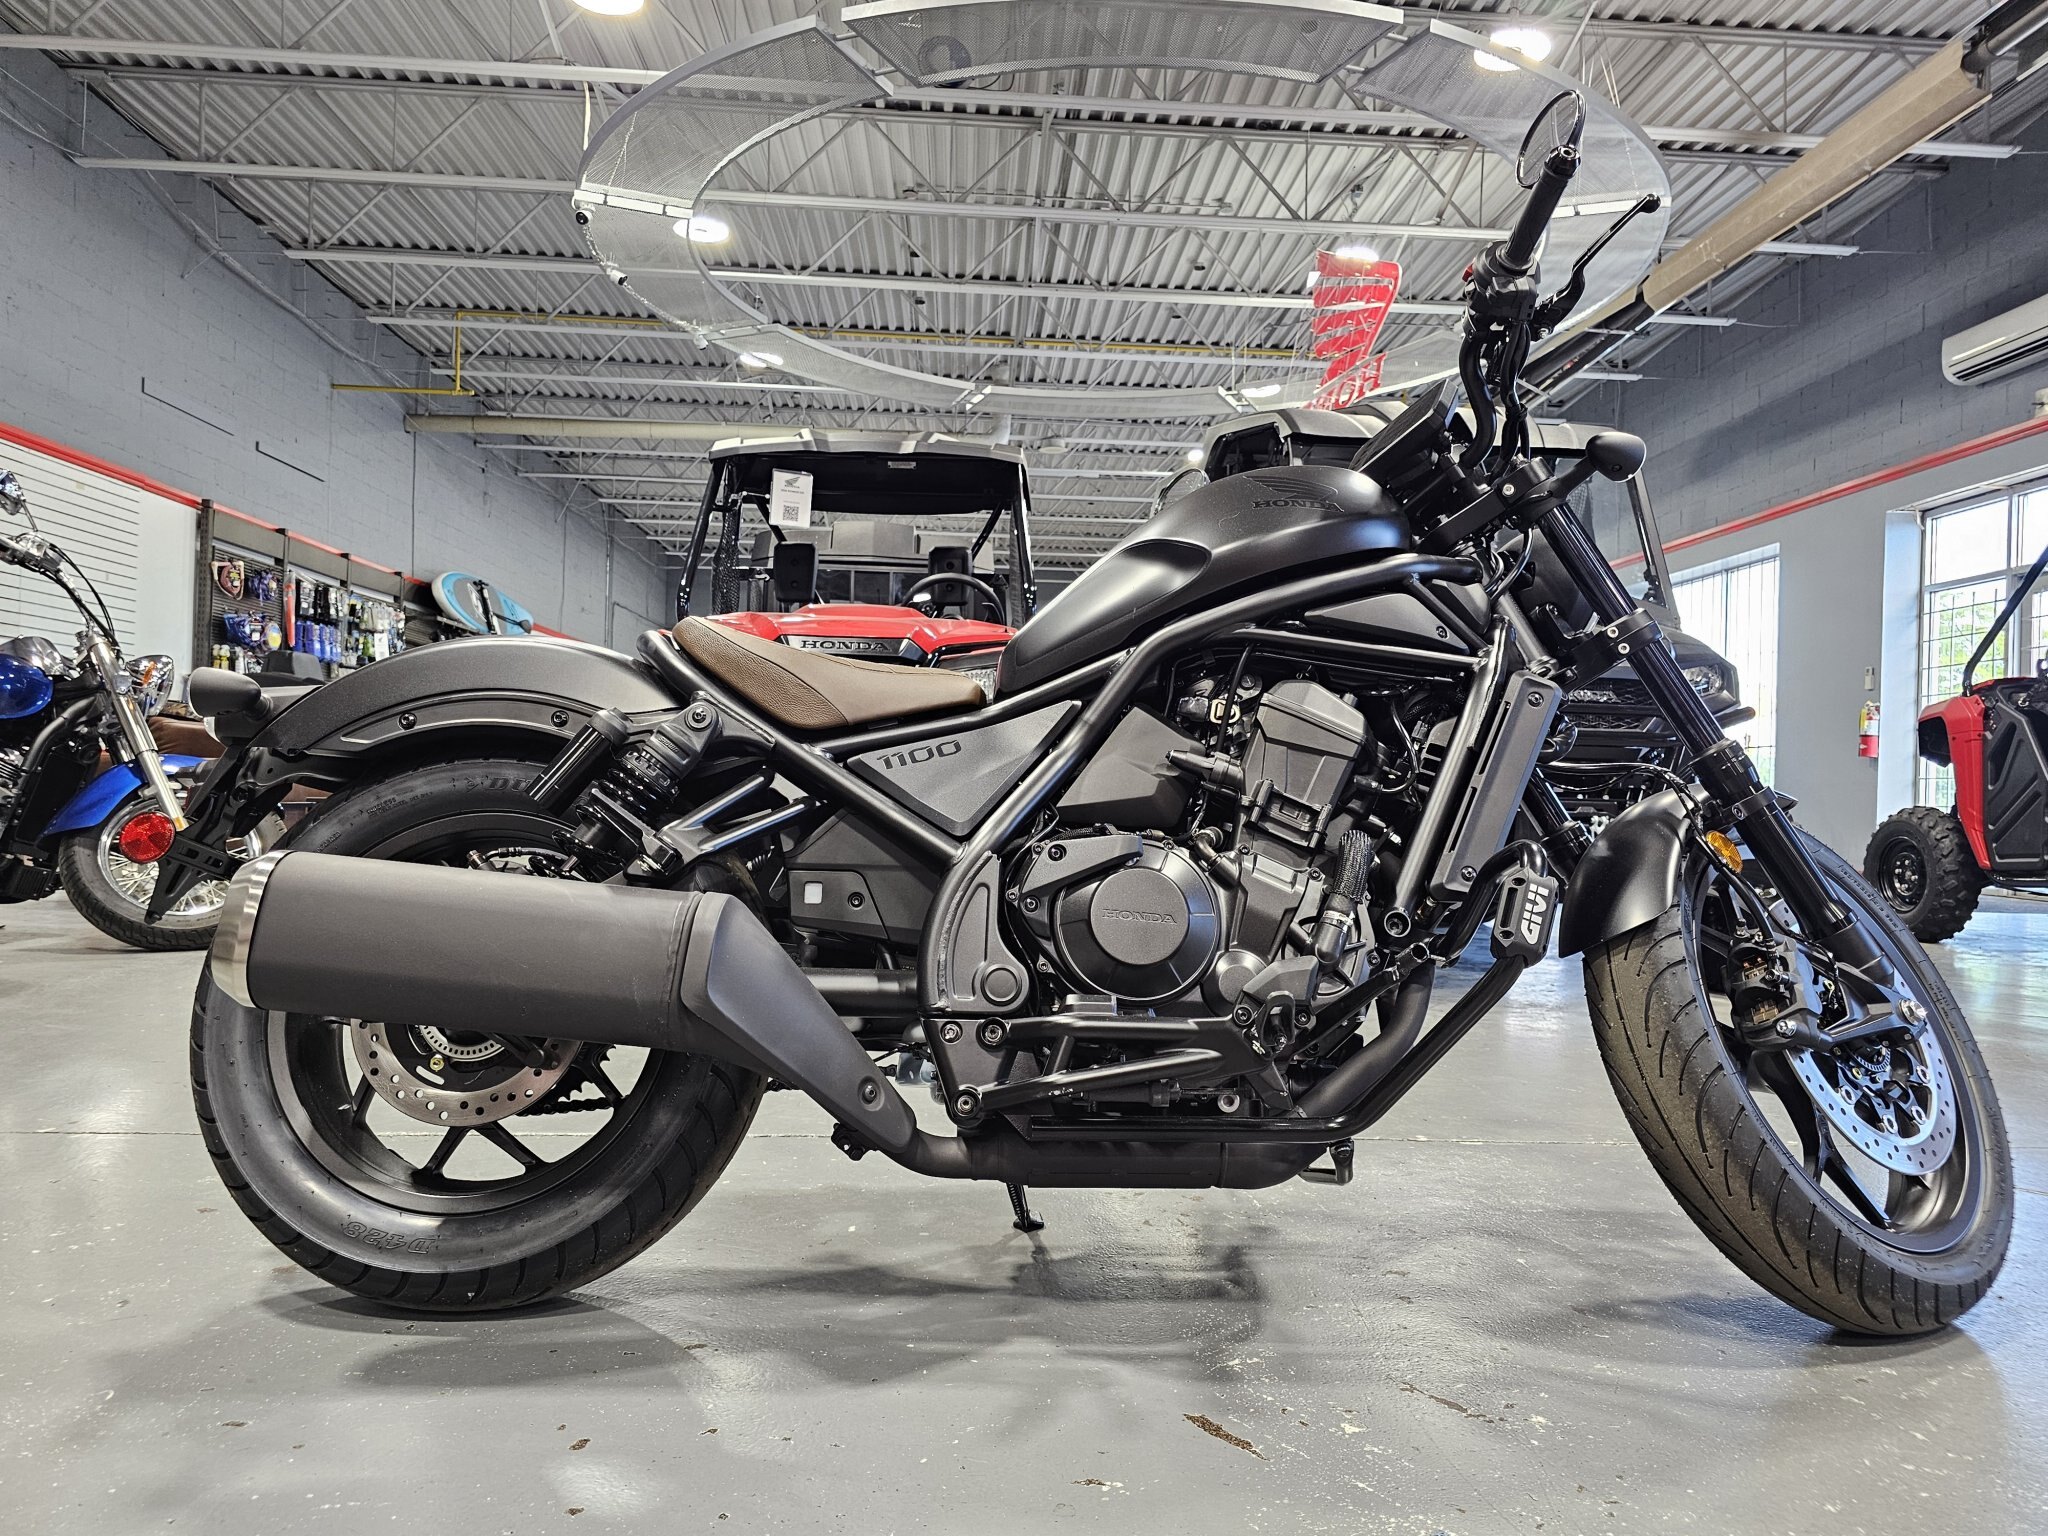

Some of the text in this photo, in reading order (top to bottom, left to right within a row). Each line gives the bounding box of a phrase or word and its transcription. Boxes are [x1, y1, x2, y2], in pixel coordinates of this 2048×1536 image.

[1252, 499, 1344, 512] HONDA
[801, 640, 889, 652] HONDA
[876, 740, 962, 770] 1100
[1101, 908, 1178, 925] HONDA
[1520, 883, 1550, 945] GIVI
[343, 1221, 436, 1255] D428
